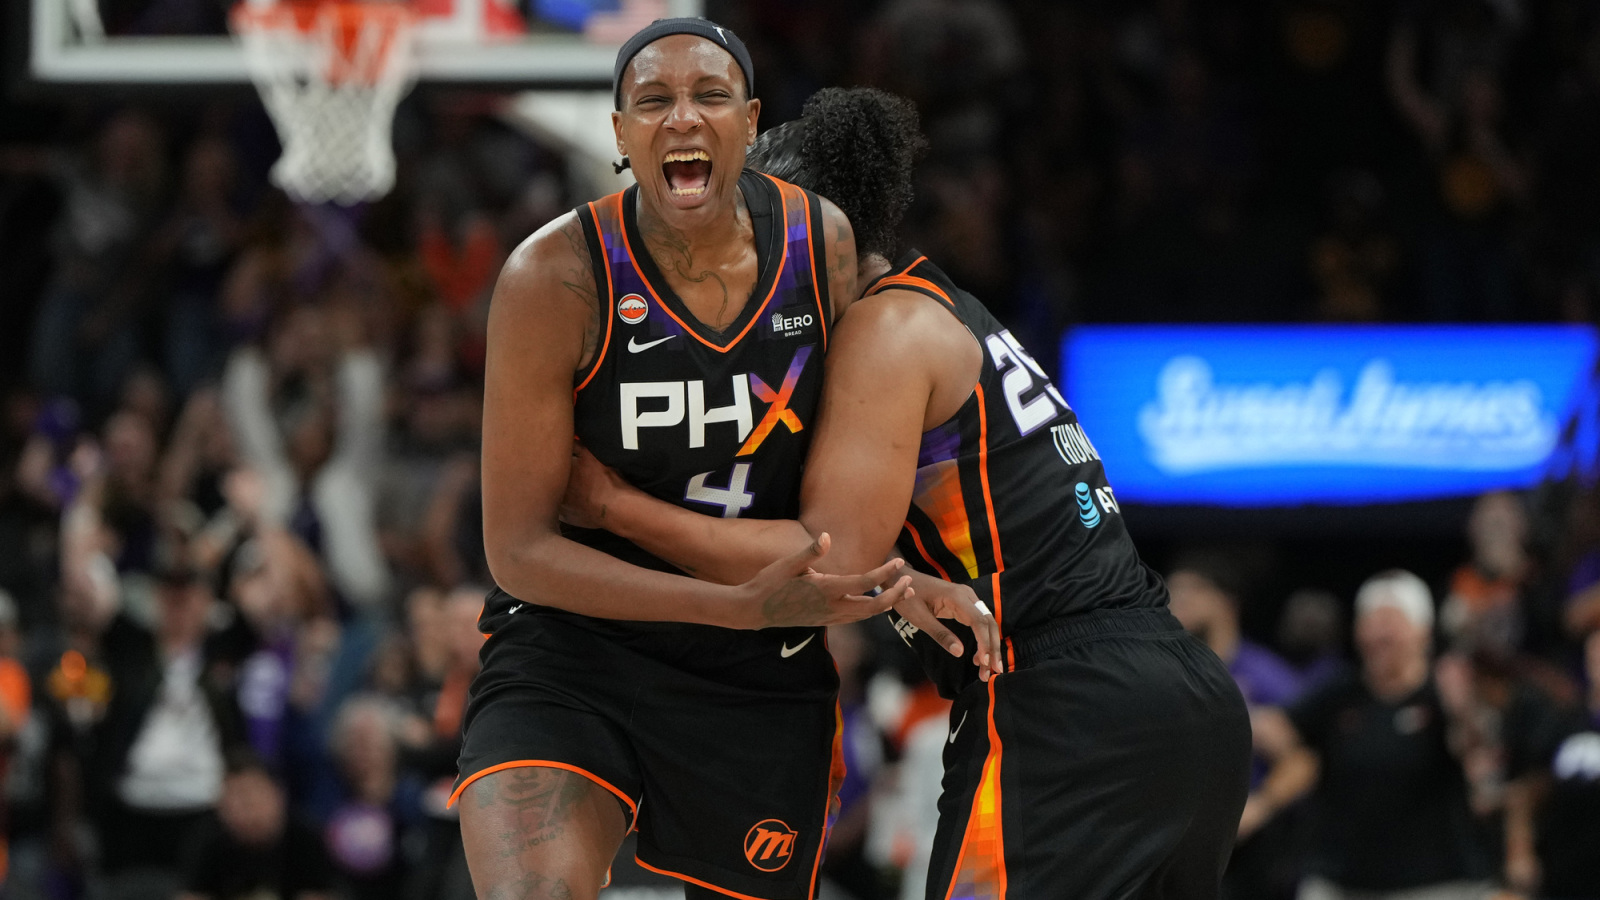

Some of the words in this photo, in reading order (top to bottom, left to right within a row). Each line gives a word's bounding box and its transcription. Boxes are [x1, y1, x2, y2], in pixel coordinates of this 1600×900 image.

[771, 312, 813, 332] HERO
[620, 345, 816, 457] PHX
[1050, 422, 1101, 465] THOM
[684, 461, 755, 518] 4
